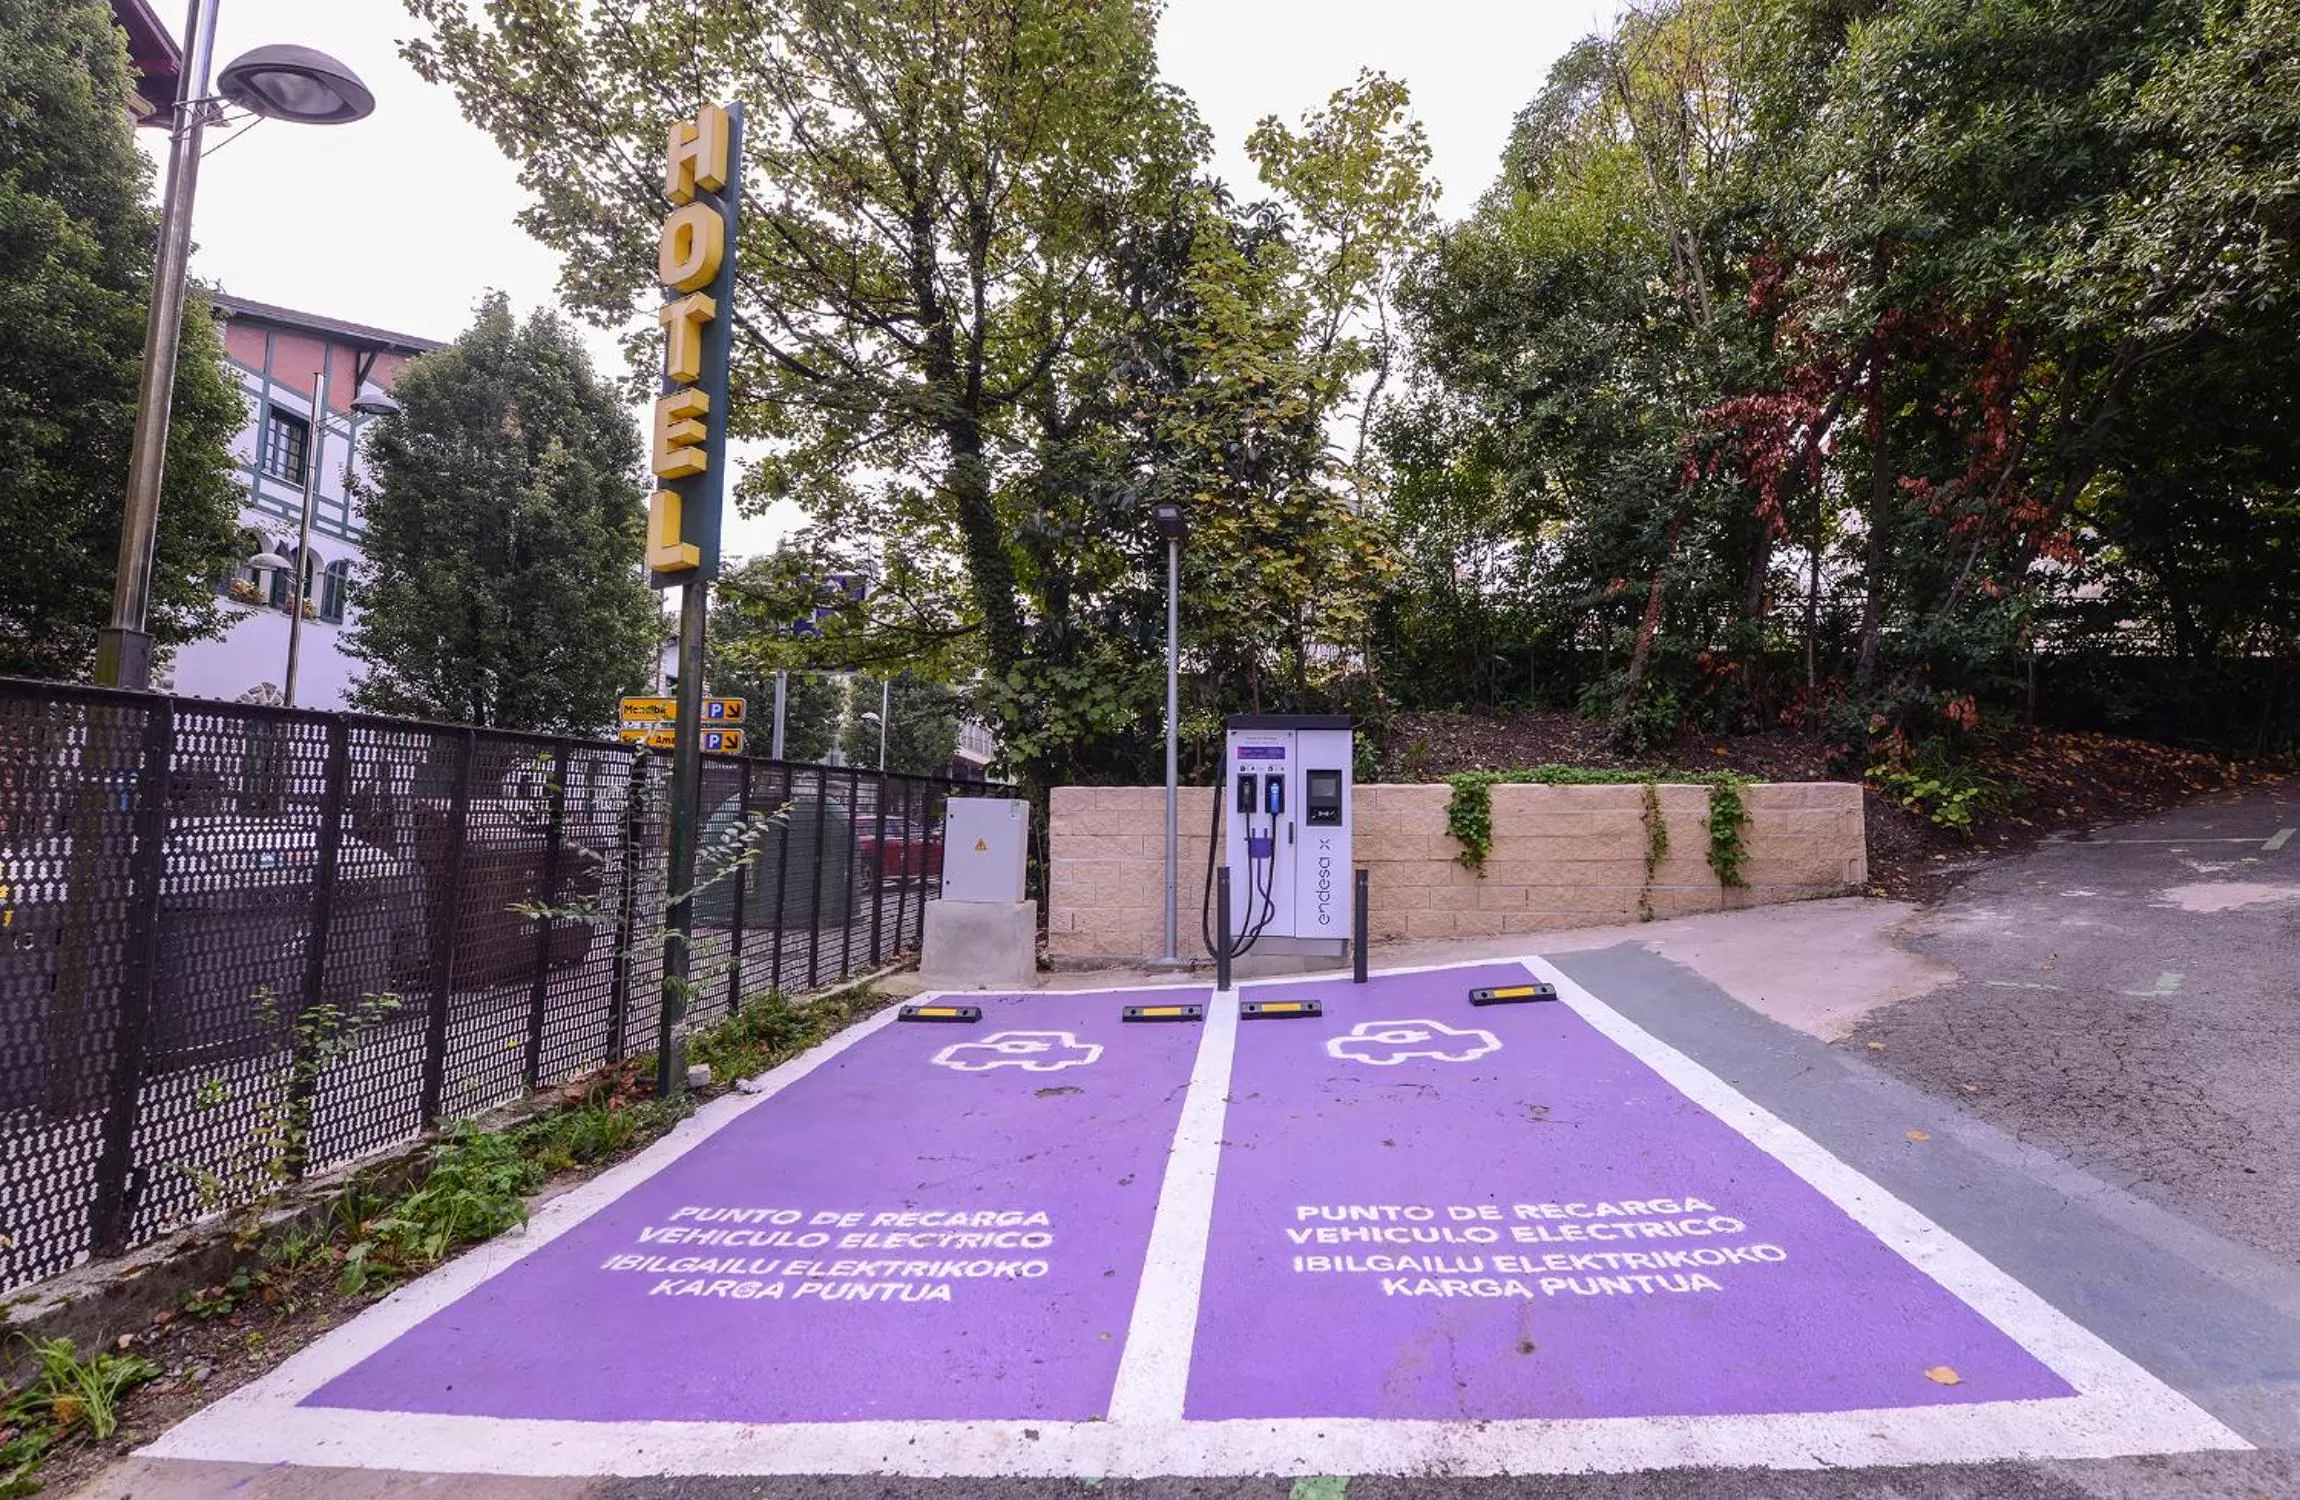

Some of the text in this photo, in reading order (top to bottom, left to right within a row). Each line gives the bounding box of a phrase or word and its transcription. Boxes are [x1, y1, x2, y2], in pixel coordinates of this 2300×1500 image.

[648, 104, 729, 573] HOTEL
[711, 703, 722, 717] P
[709, 734, 720, 748] P
[1315, 857, 1331, 926] endesa
[670, 1207, 1050, 1228] PUNTO DE RECARGA
[1296, 1197, 1716, 1221] PUNTO DE RECARGA
[638, 1227, 1053, 1249] VEHICULO ELECTRICO
[1285, 1215, 1746, 1244] VEHICULO ELECTRICO
[601, 1254, 1049, 1279] IBILGAILU ELEKTRIKOKO
[1293, 1243, 1787, 1274] IBILGAILU ELEKTRIKOKO
[649, 1278, 951, 1302] KARGA PUNTUA
[1381, 1273, 1723, 1299] KARGA PUNTUA
